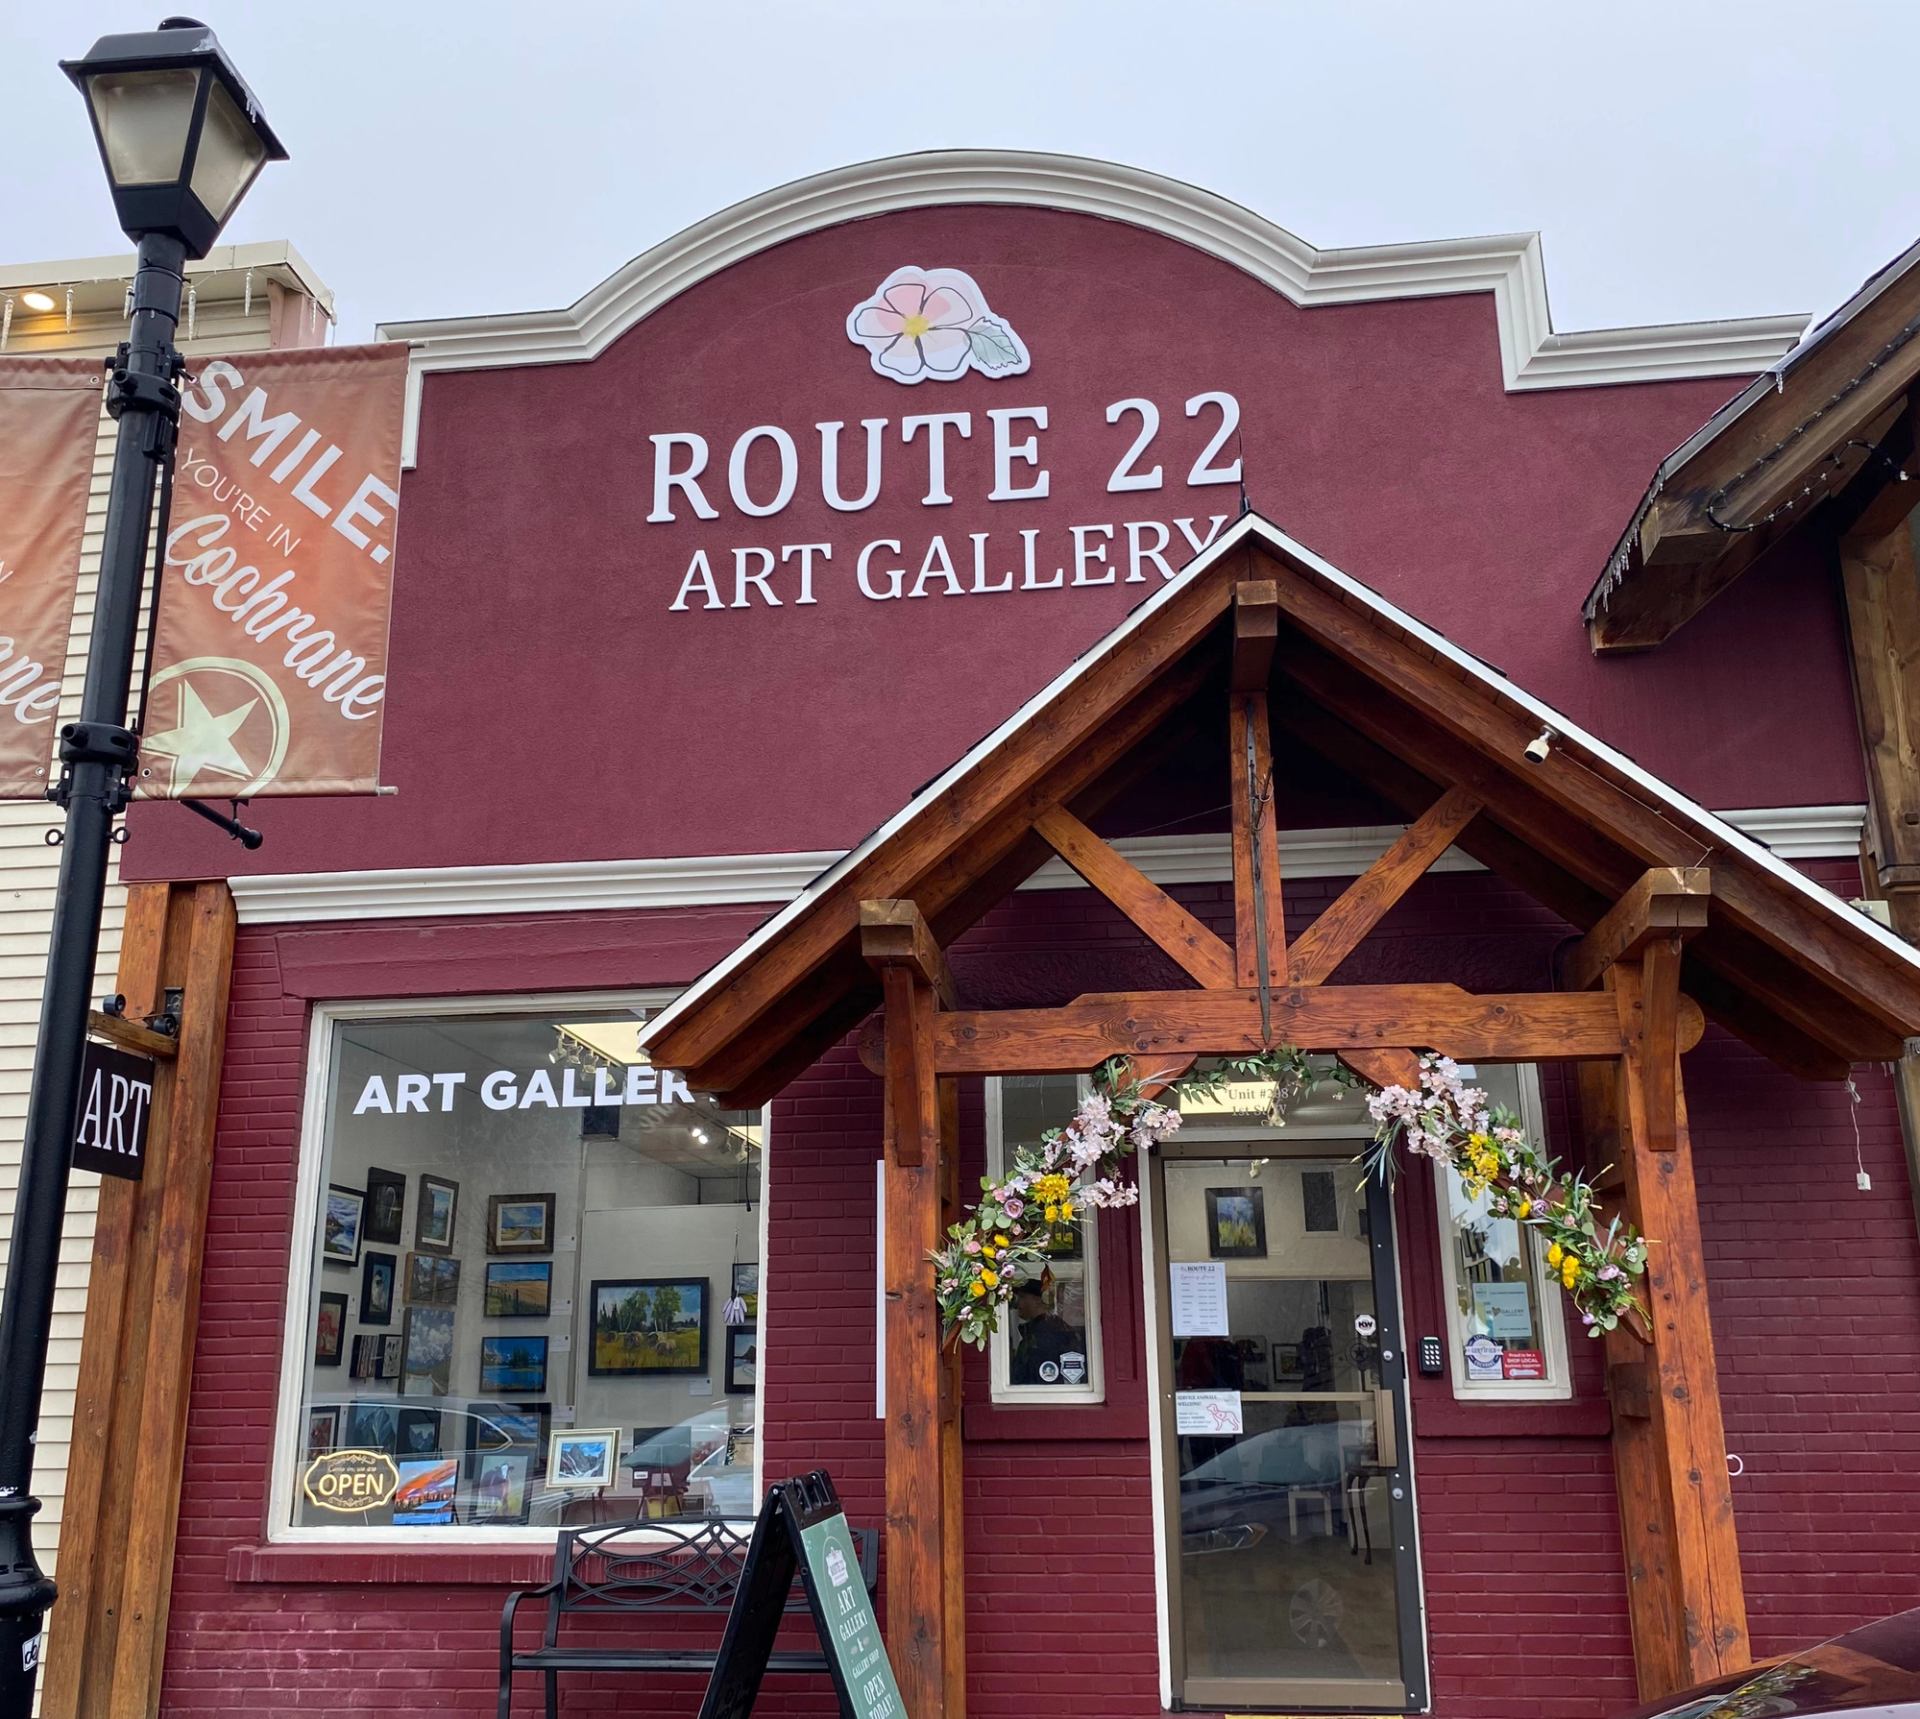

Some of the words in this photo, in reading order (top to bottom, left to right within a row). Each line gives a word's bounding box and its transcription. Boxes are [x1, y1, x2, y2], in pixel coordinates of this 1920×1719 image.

[181, 361, 397, 564] SMILE.
[646, 406, 1050, 523] ROUTE
[1106, 391, 1241, 492] 22
[181, 448, 272, 535] YOU'RE
[264, 522, 302, 558] IN
[669, 543, 832, 611] ART
[856, 515, 1228, 600] GALLERY
[165, 513, 385, 720] Cochrane
[76, 1068, 152, 1157] ART
[353, 1072, 466, 1115] ART
[1228, 1088, 1255, 1100] Unit
[1231, 1106, 1250, 1117] 1st
[319, 1473, 384, 1496] OPEN
[837, 1585, 857, 1617] ART
[839, 1609, 868, 1643] GALLERY
[868, 1648, 880, 1665] SHOP
[863, 1671, 886, 1705] OPEN
